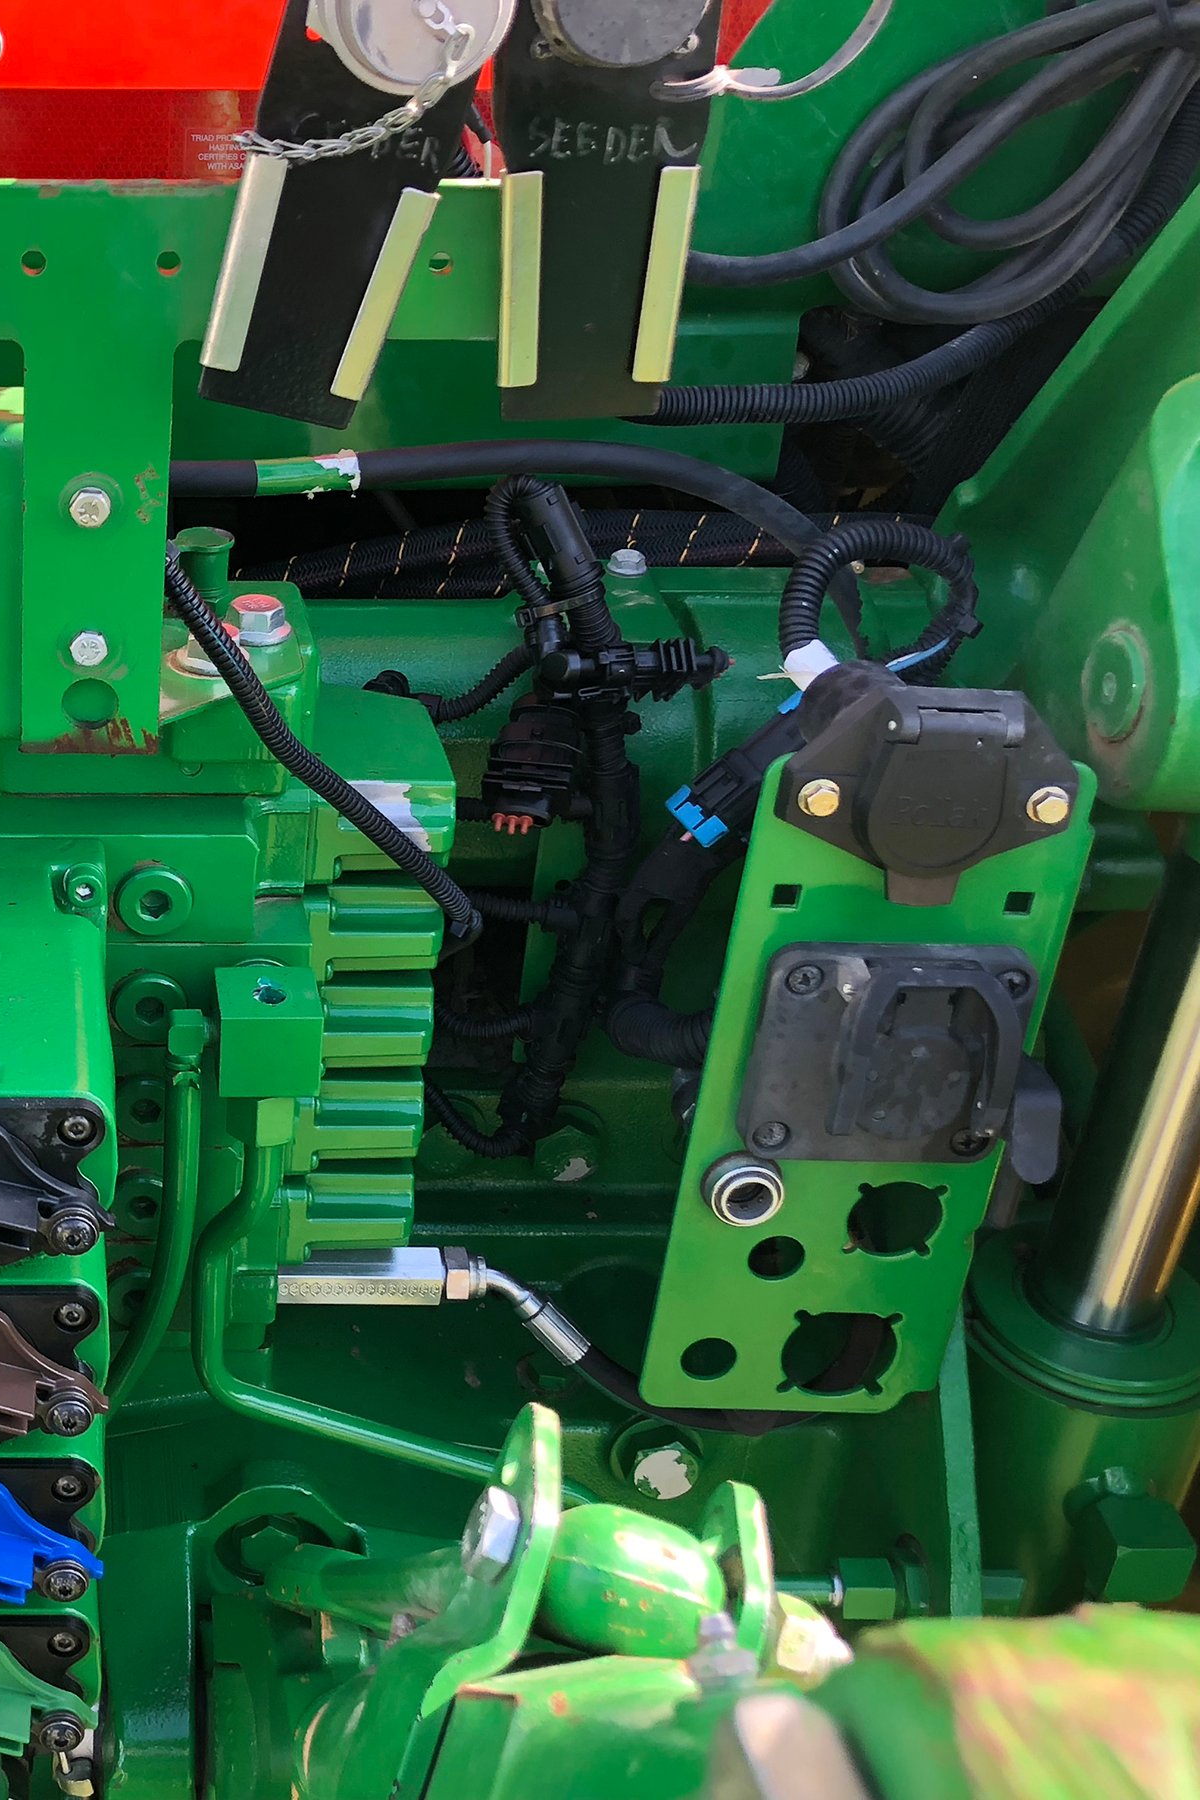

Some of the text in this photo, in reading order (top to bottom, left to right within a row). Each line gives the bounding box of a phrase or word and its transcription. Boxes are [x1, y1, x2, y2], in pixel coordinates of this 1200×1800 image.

[191, 134, 235, 142] TRIAD PRO
[528, 115, 698, 166] SEEDER
[197, 153, 238, 161] CERTIFIES
[207, 162, 227, 170] WITH
